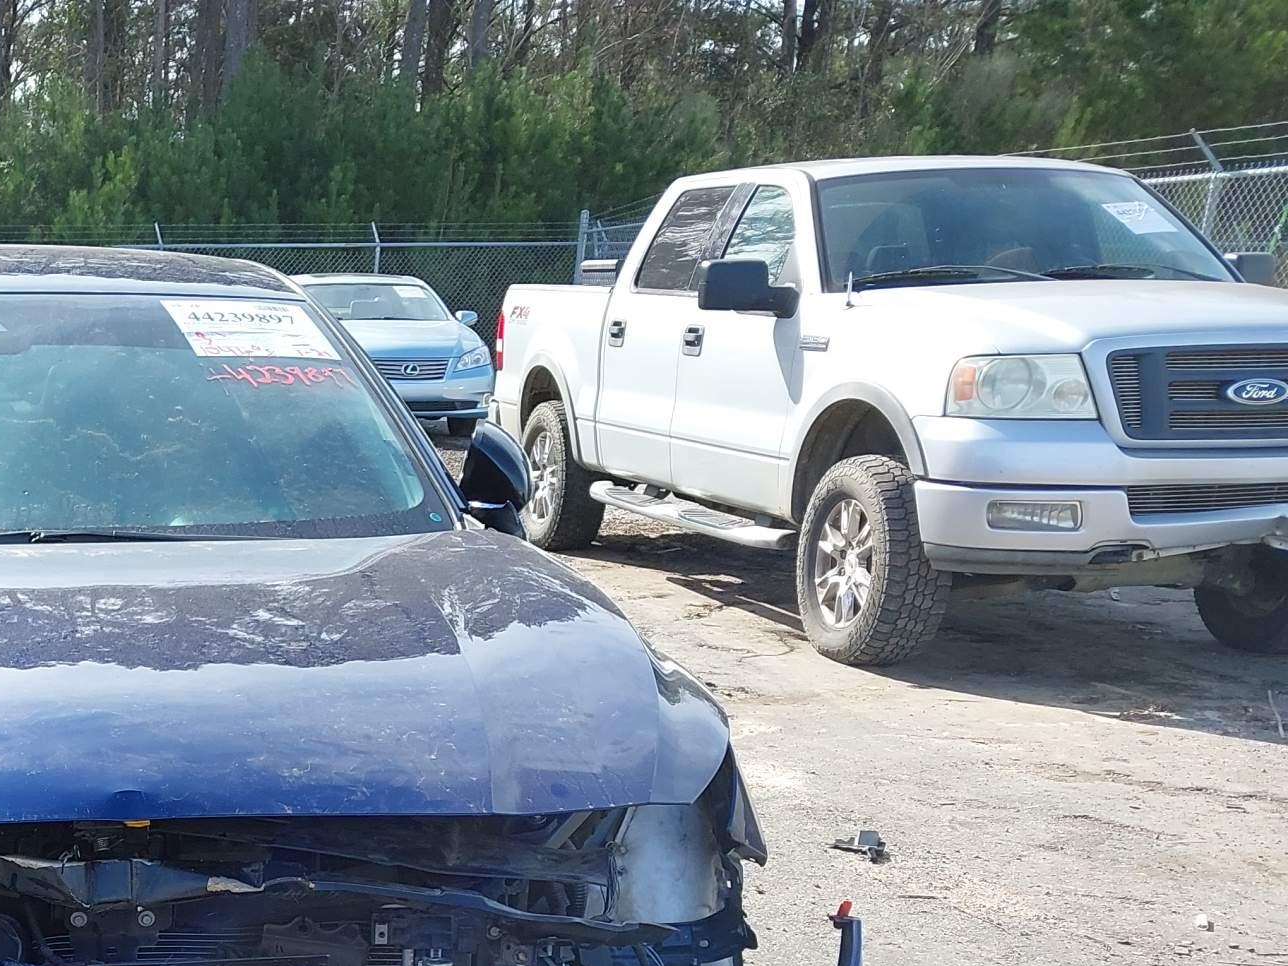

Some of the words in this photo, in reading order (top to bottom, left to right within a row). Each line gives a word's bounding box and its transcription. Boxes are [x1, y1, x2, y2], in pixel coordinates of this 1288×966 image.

[187, 311, 294, 325] 44239897
[510, 305, 531, 320] FX4
[1242, 383, 1278, 399] Ford
